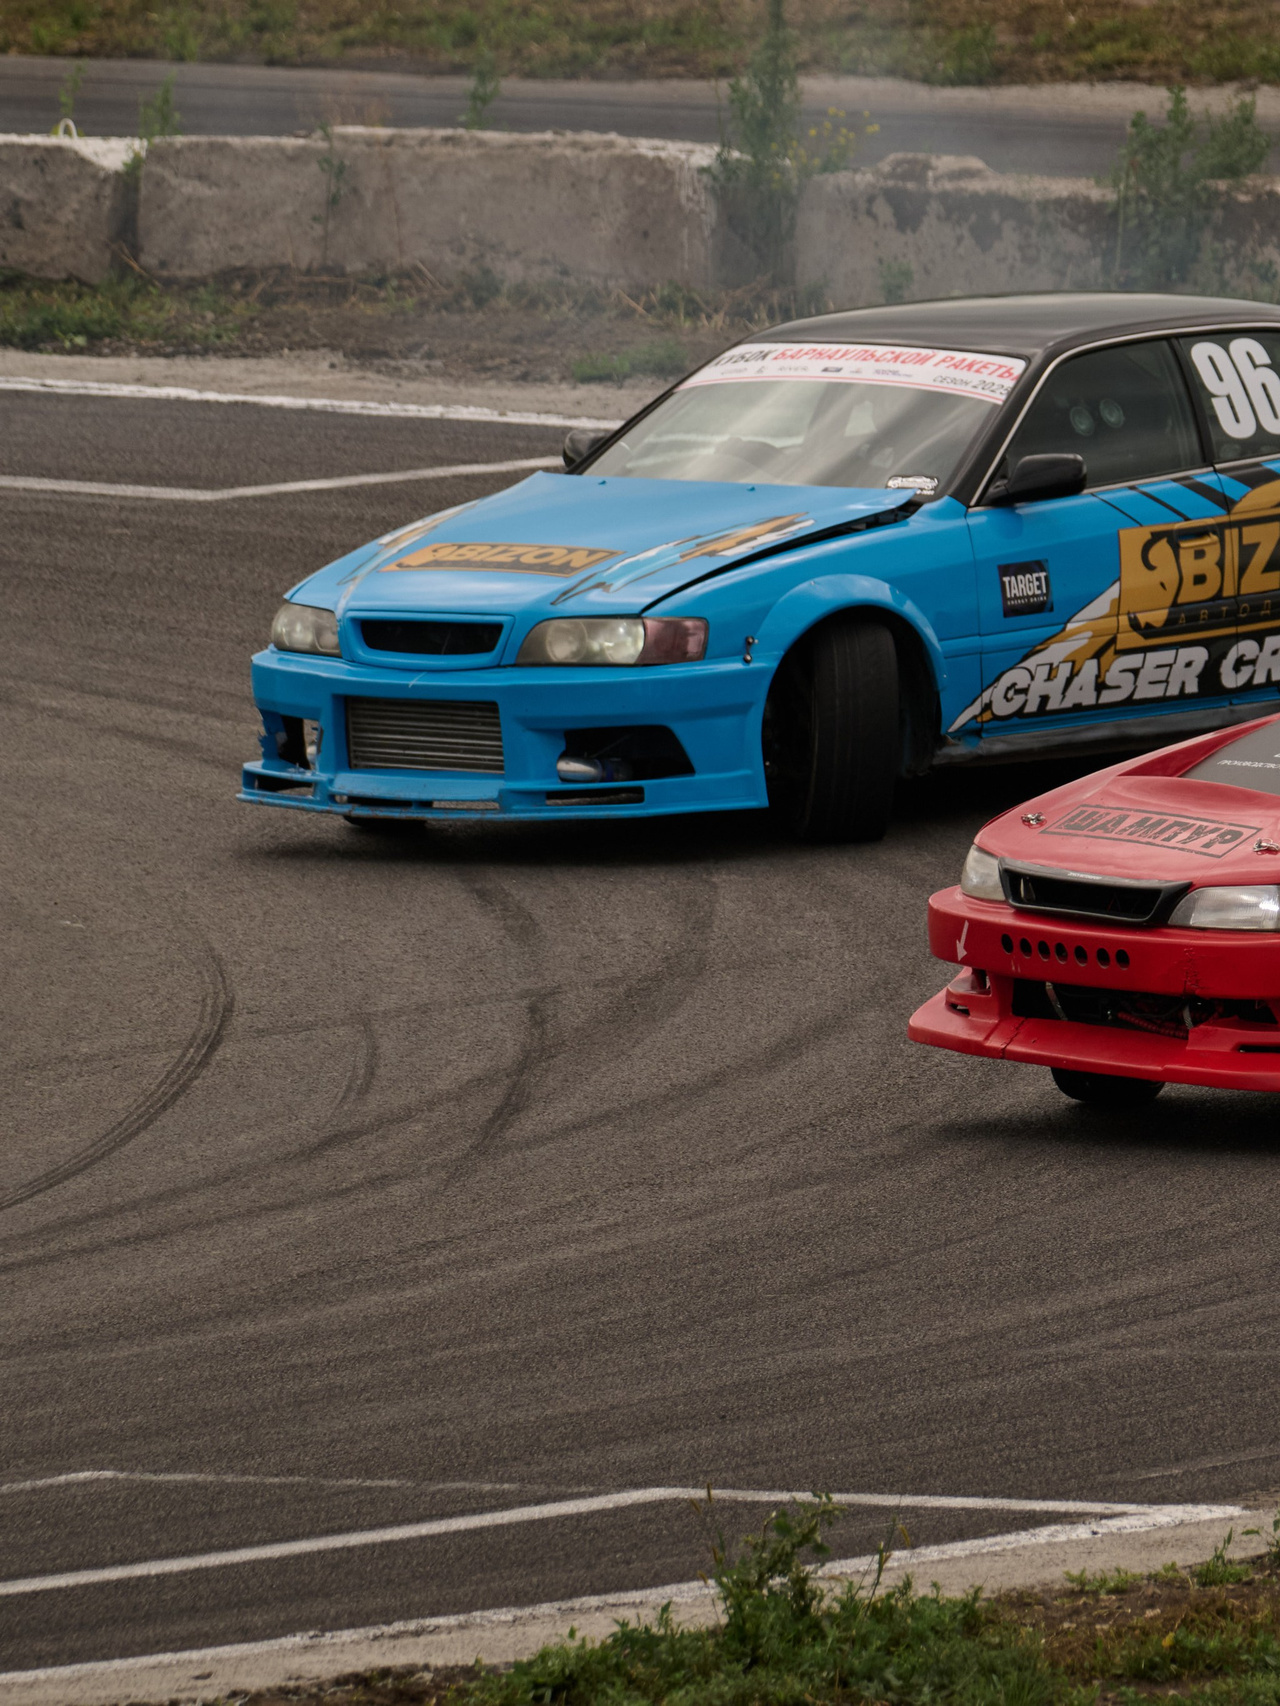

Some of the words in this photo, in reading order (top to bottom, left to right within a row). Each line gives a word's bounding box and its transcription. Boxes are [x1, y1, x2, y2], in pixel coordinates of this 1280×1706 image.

[772, 348, 937, 367] БАРНАУЛЬСКОЙ
[933, 375, 973, 388] СЕЗОН
[443, 545, 614, 568] BIZON
[1002, 572, 1047, 598] TARGET
[990, 645, 1209, 717] CHASER
[1056, 809, 1244, 850] ШАМПУР
